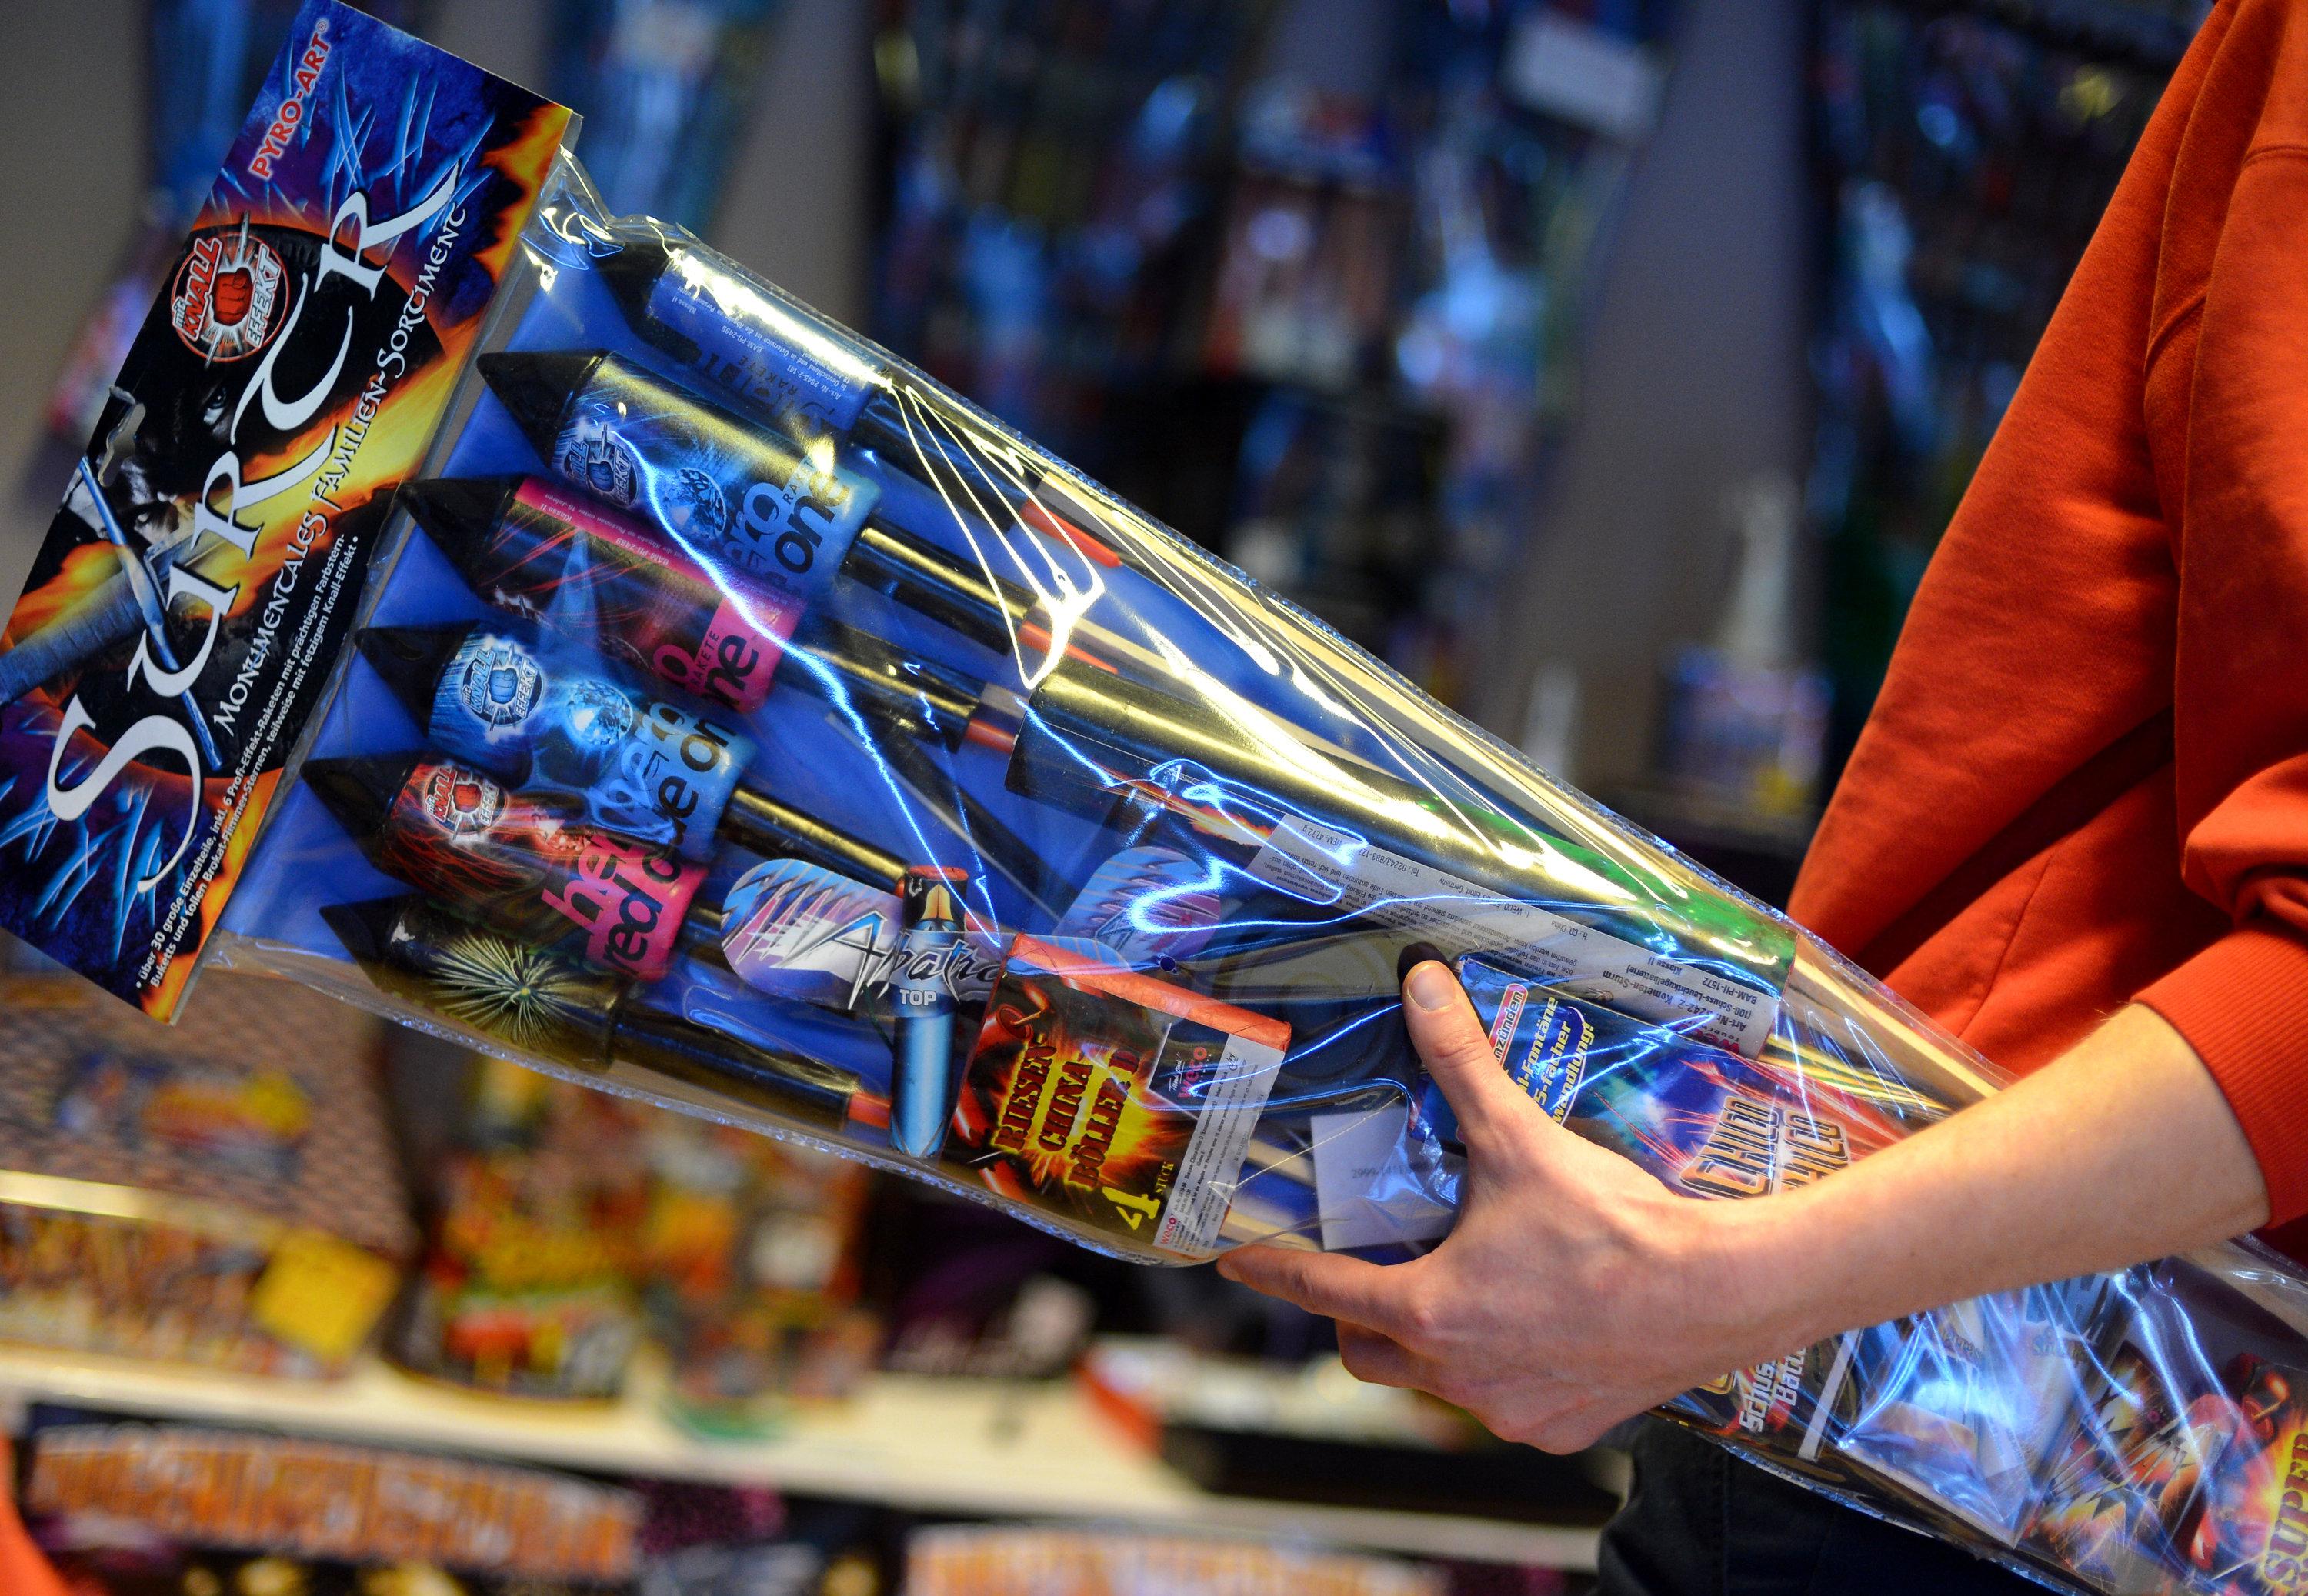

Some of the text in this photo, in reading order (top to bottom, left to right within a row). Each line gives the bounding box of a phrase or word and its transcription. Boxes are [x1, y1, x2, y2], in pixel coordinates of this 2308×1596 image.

[181, 238, 222, 340] KNALL
[246, 243, 285, 348] EFFEKT
[463, 648, 496, 716] KNALL
[514, 652, 543, 719] EFFEKT
[703, 632, 760, 711] ne
[137, 532, 349, 980] über 30 große Einzelteile, inkl. 6 Profi-Effekt-Raketen mit prächtigen Farbstern-
[148, 542, 361, 988] Buketts und tollen Brokat-Flimmer-Sternen, teilweise mit fetzigem Knall-Effekt
[679, 715, 733, 773] on
[430, 768, 458, 825] KNALL
[1368, 882, 1384, 894] Ende
[1436, 875, 1465, 893] Germany
[602, 872, 664, 974] red
[899, 988, 937, 1006] TOP
[1603, 968, 1674, 1006] Kometen-Sturm
[1654, 958, 1682, 976] Klasse
[1494, 990, 1525, 1061] nzünden
[1516, 996, 1559, 1093] l-Fontäne
[1550, 1021, 1596, 1125] wandlung!
[1066, 1048, 1142, 1186] BÖLLER D
[1680, 1095, 1779, 1200] CHICO
[1781, 1111, 1847, 1193] HICO
[1101, 1185, 1160, 1230] 4
[1739, 1364, 1780, 1432] Schus
